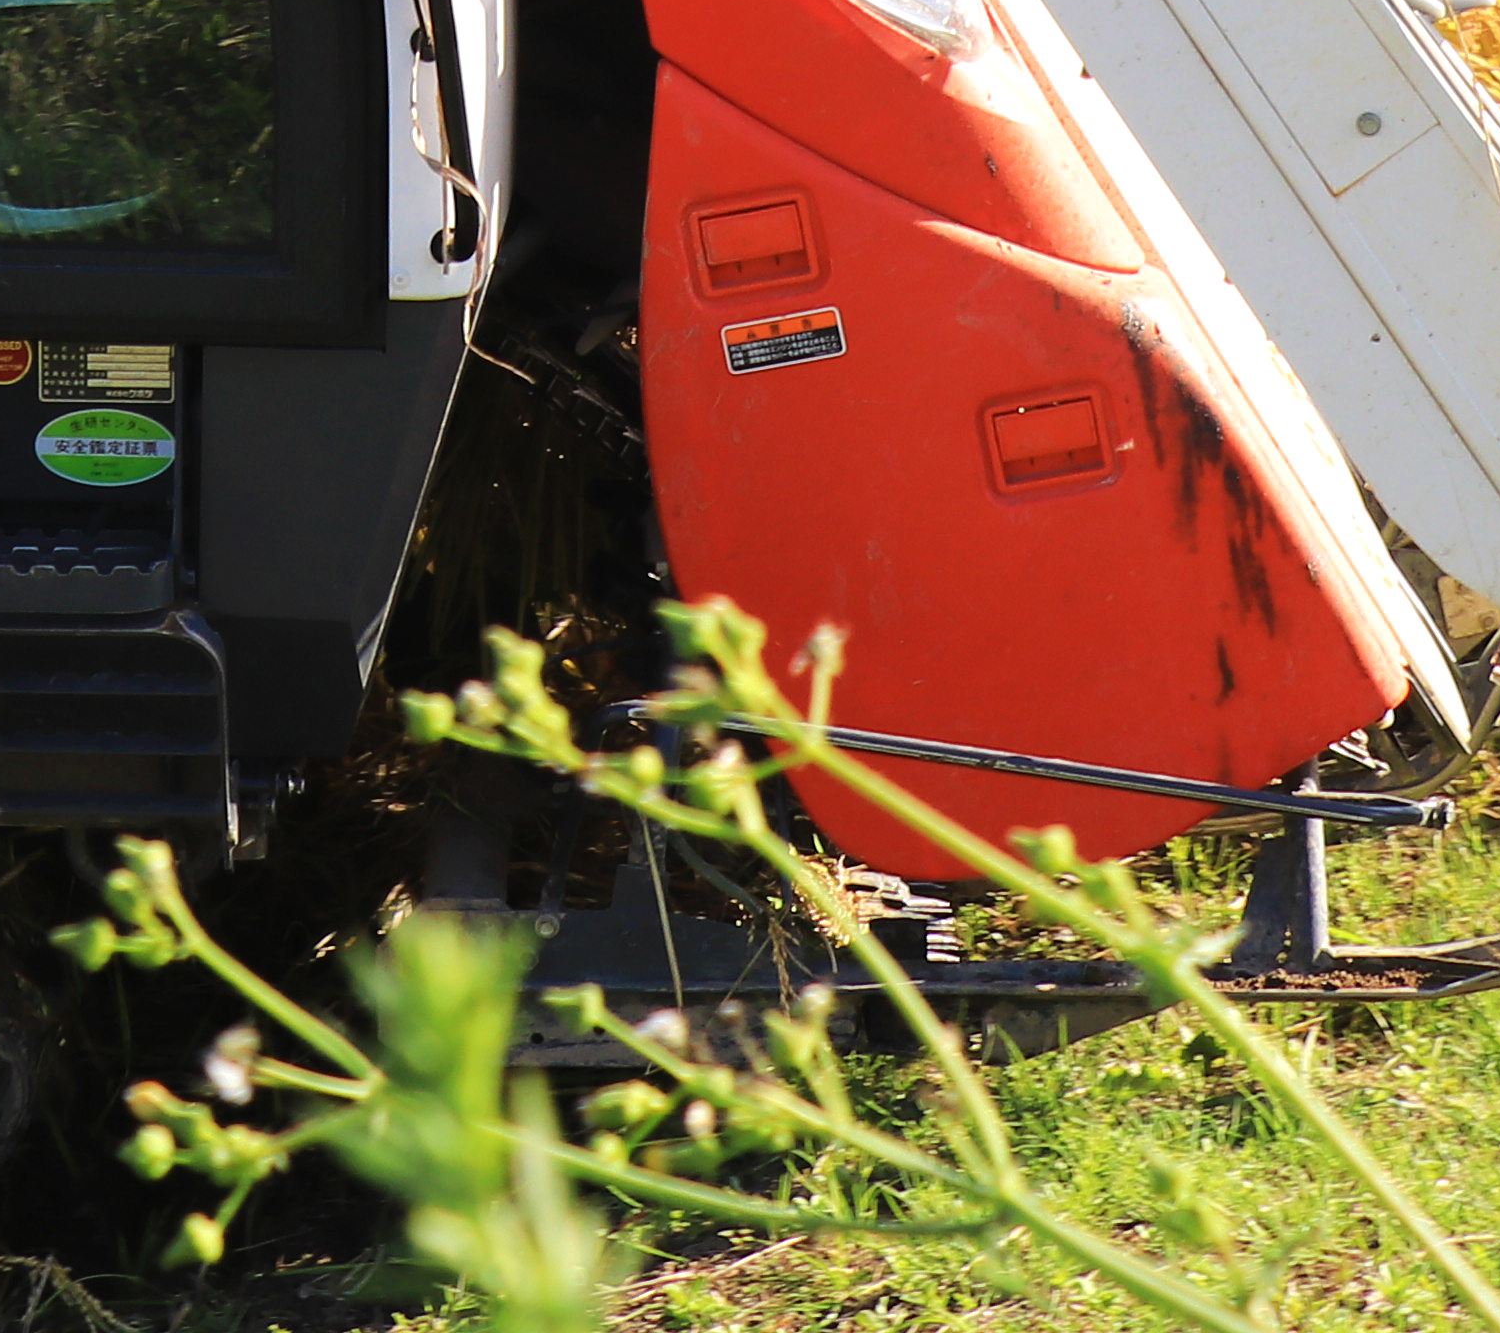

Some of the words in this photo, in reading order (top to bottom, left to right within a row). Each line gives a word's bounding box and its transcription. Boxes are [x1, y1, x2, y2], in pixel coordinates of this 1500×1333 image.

[55, 439, 157, 456] 安全鑑定証票
